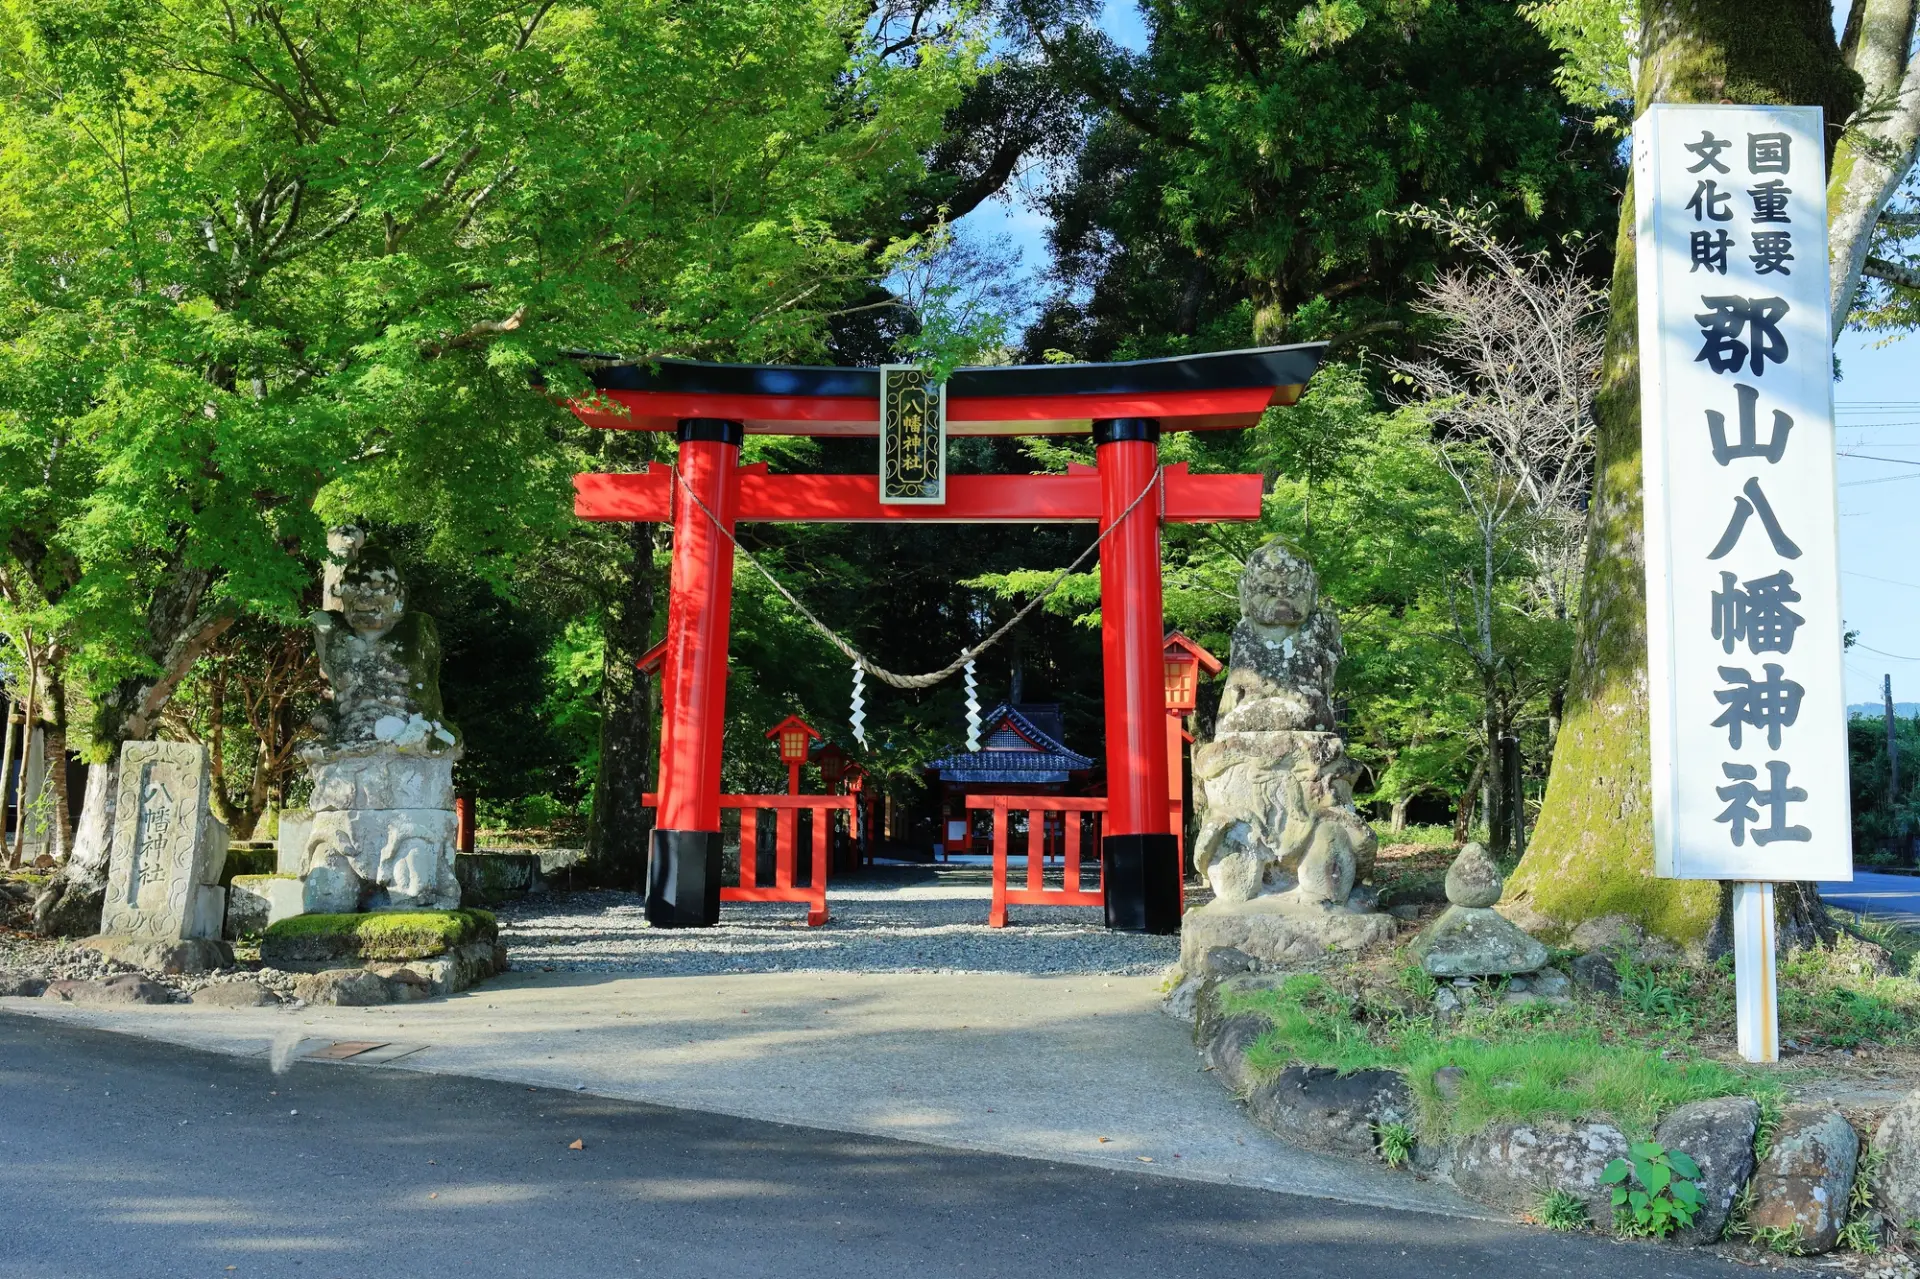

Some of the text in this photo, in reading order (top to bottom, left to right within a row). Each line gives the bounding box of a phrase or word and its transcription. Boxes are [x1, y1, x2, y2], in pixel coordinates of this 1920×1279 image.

[1684, 130, 1736, 276] 文化財
[1746, 131, 1795, 277] 国重要
[902, 399, 924, 471] 八幡神社
[1693, 294, 1813, 847] 郡山八幡神社
[138, 782, 173, 887] 八幡神社
